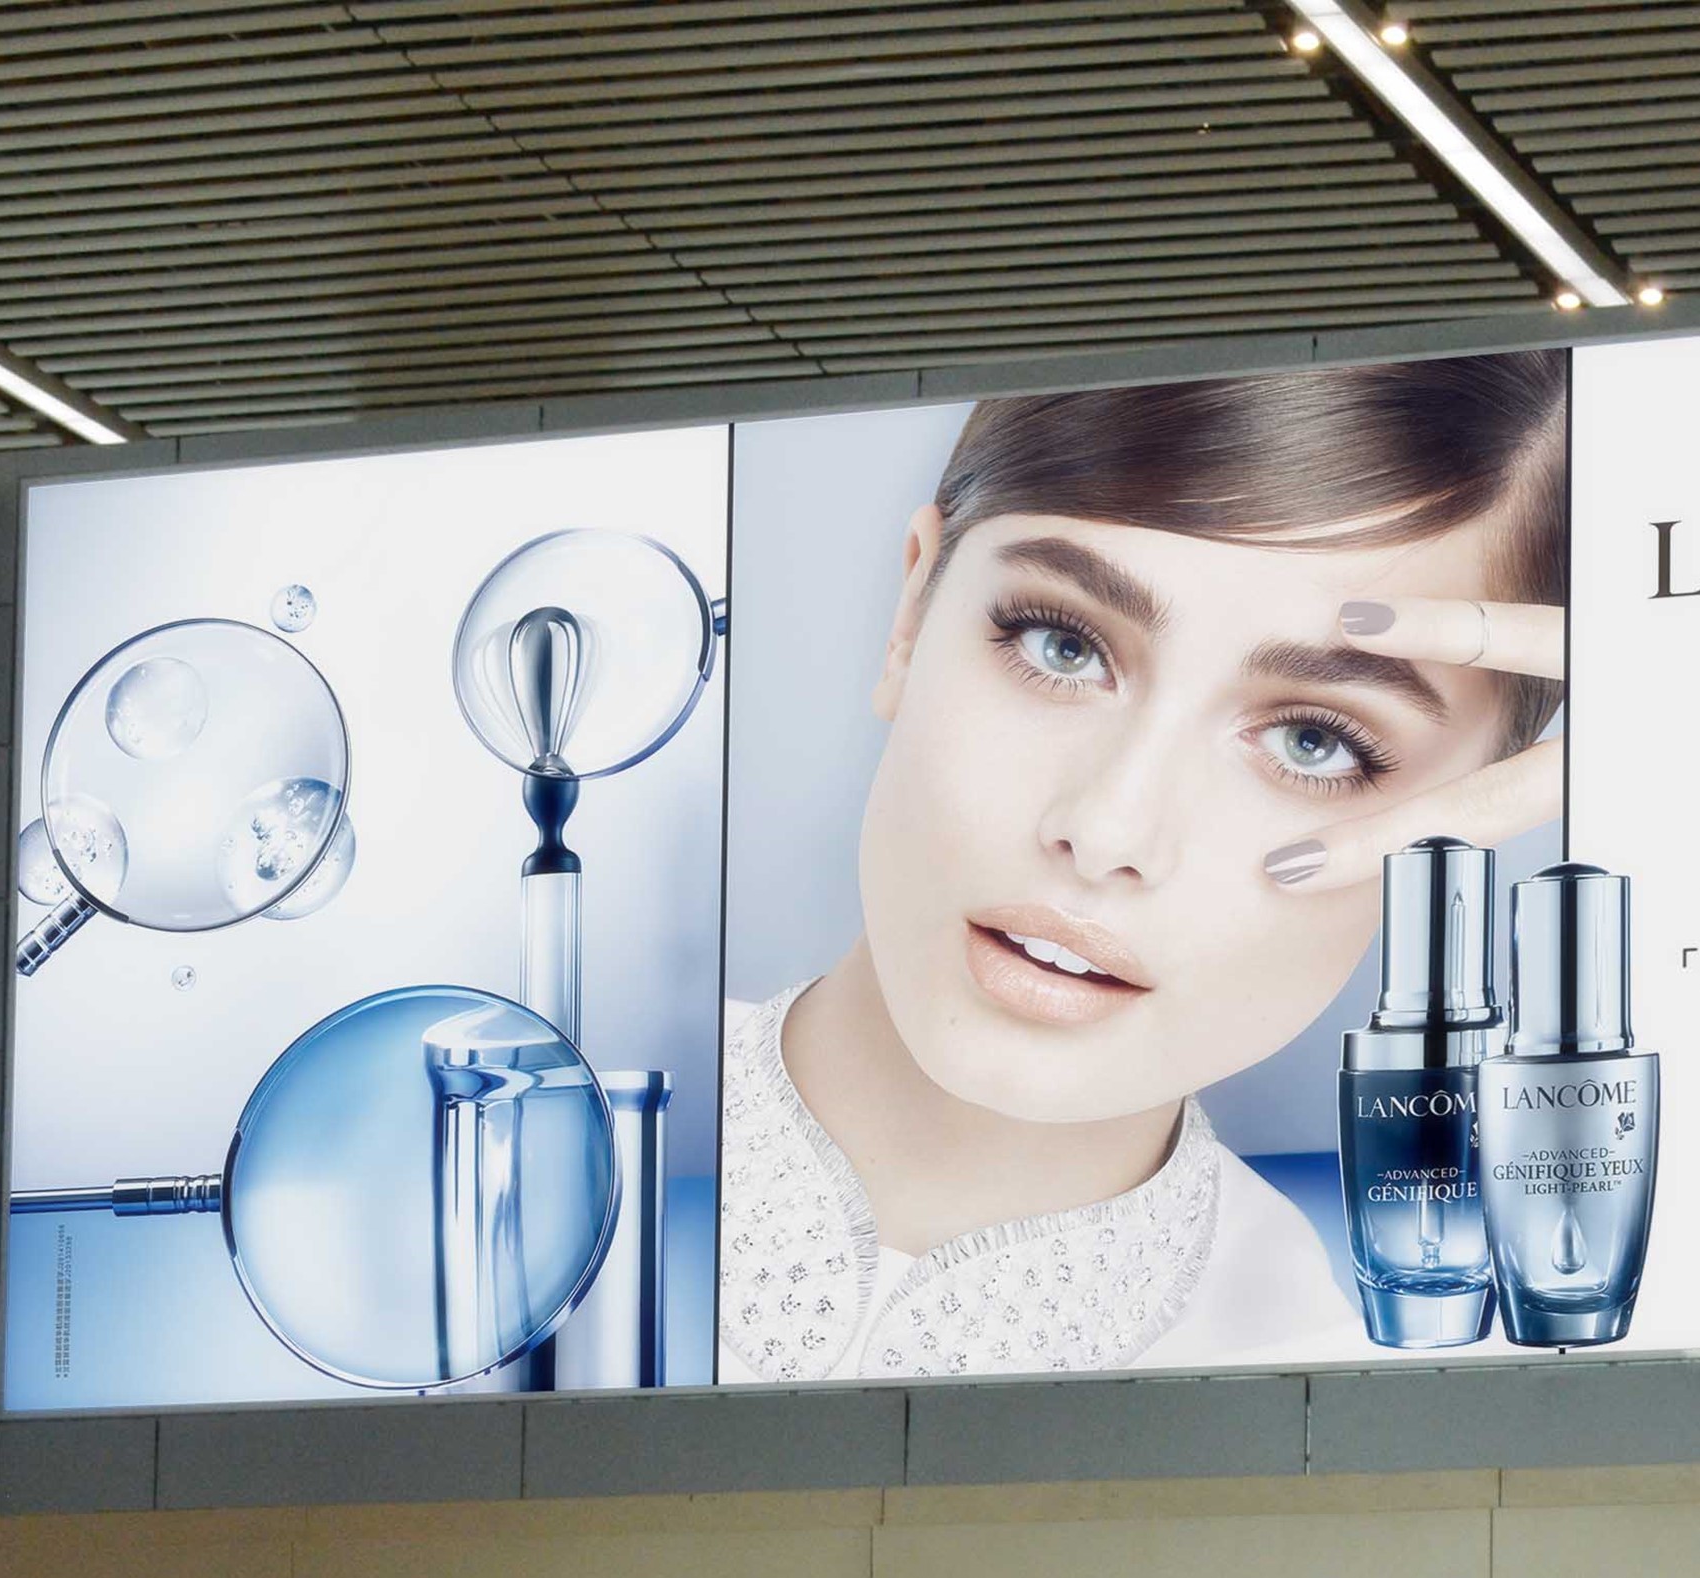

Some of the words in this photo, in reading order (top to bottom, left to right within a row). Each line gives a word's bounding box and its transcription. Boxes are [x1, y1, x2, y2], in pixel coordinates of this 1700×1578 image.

[1357, 1090, 1476, 1119] LANCÔM
[1502, 1077, 1638, 1110] LANCÔME
[1493, 1160, 1597, 1181] GÉNIFIQUE
[1599, 1157, 1645, 1176] YEUX
[1367, 1178, 1477, 1203] GÉNIFIQUE
